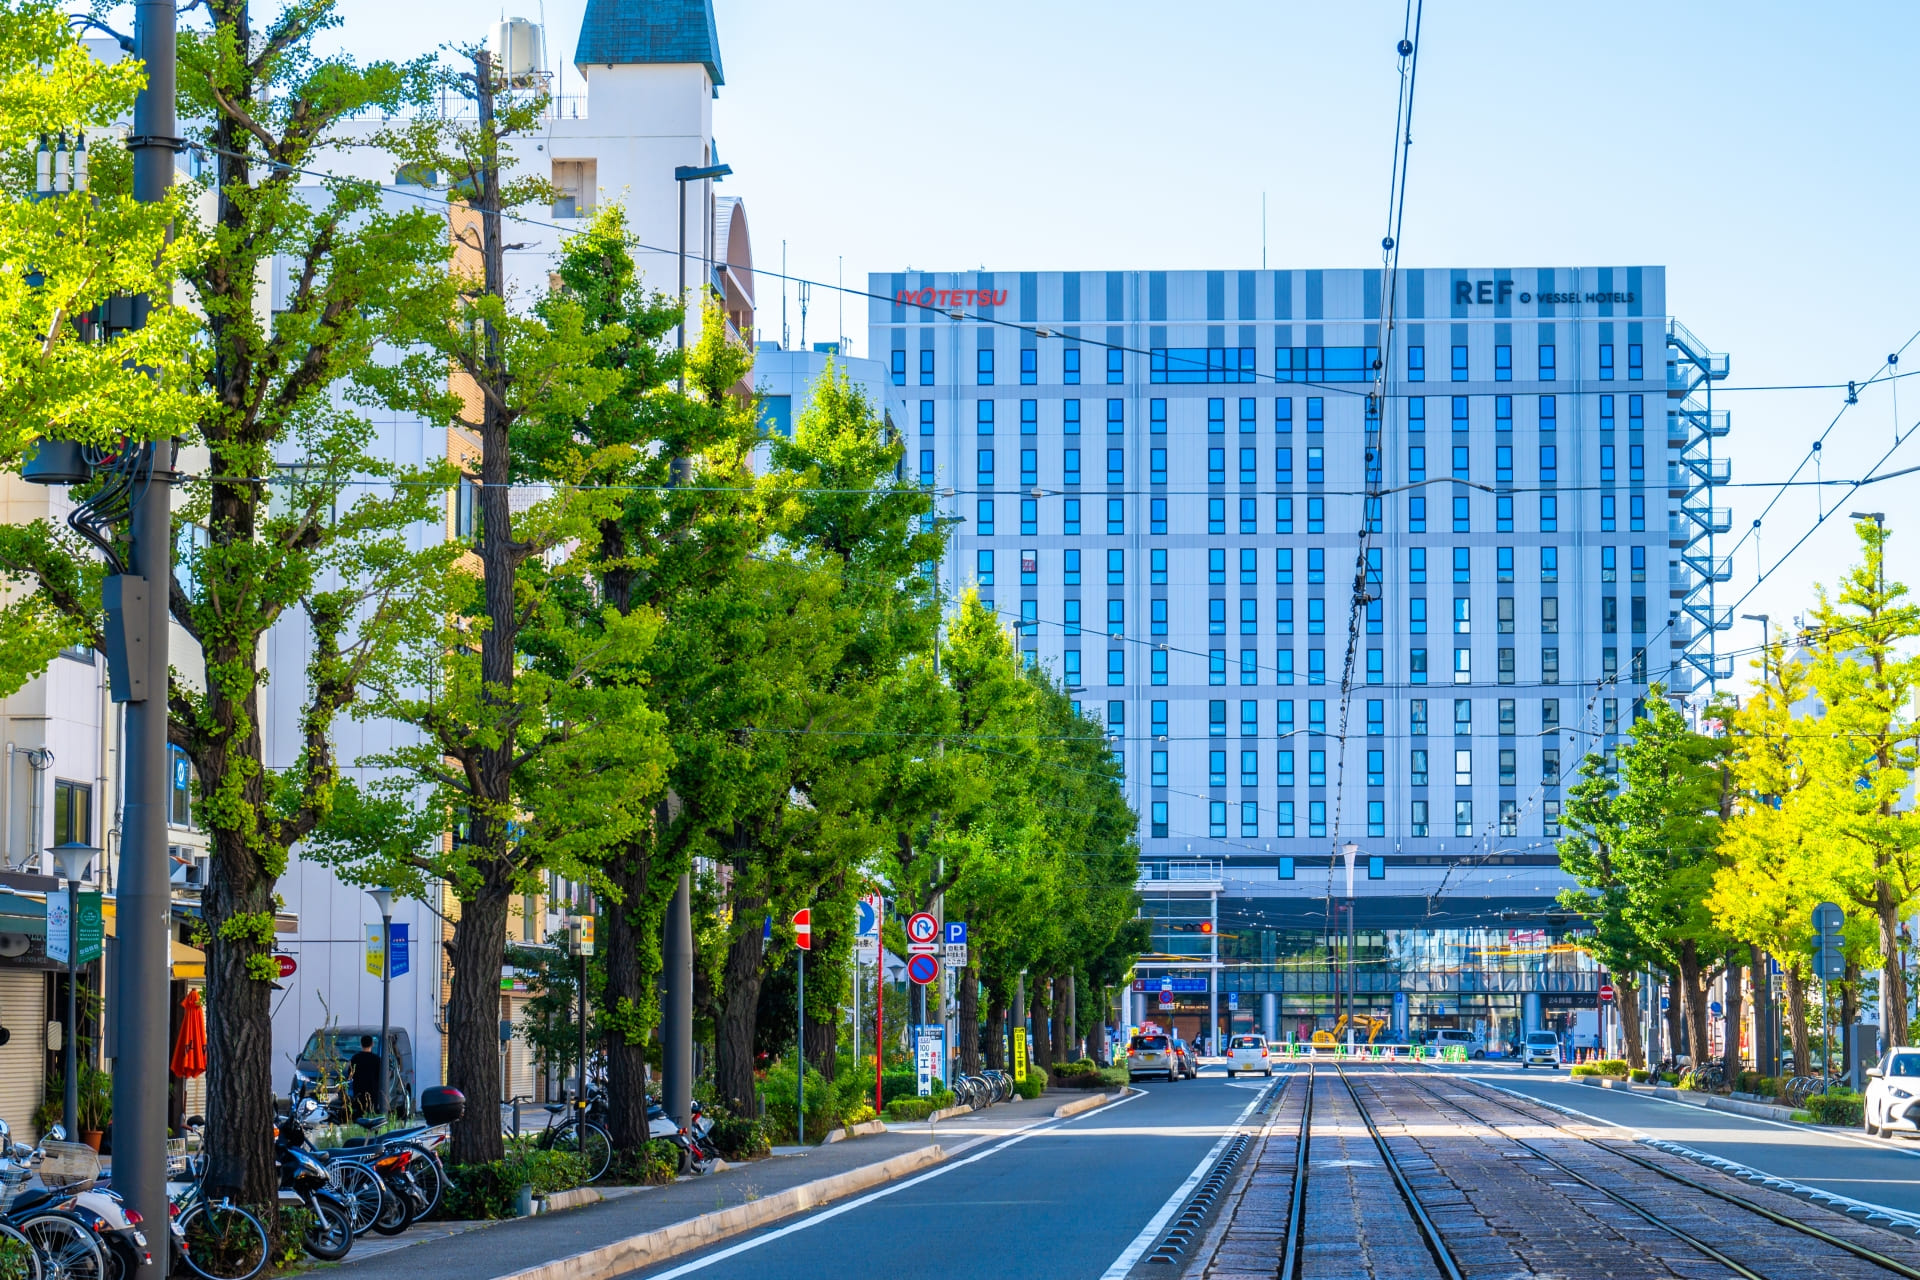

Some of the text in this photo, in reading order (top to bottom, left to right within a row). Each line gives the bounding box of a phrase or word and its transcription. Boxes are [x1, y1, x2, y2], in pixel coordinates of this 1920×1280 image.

[896, 287, 1008, 307] IYOTETSU
[1456, 280, 1635, 305] REF VESSEL HOTELS
[951, 925, 963, 941] P
[919, 1044, 930, 1052] 100
